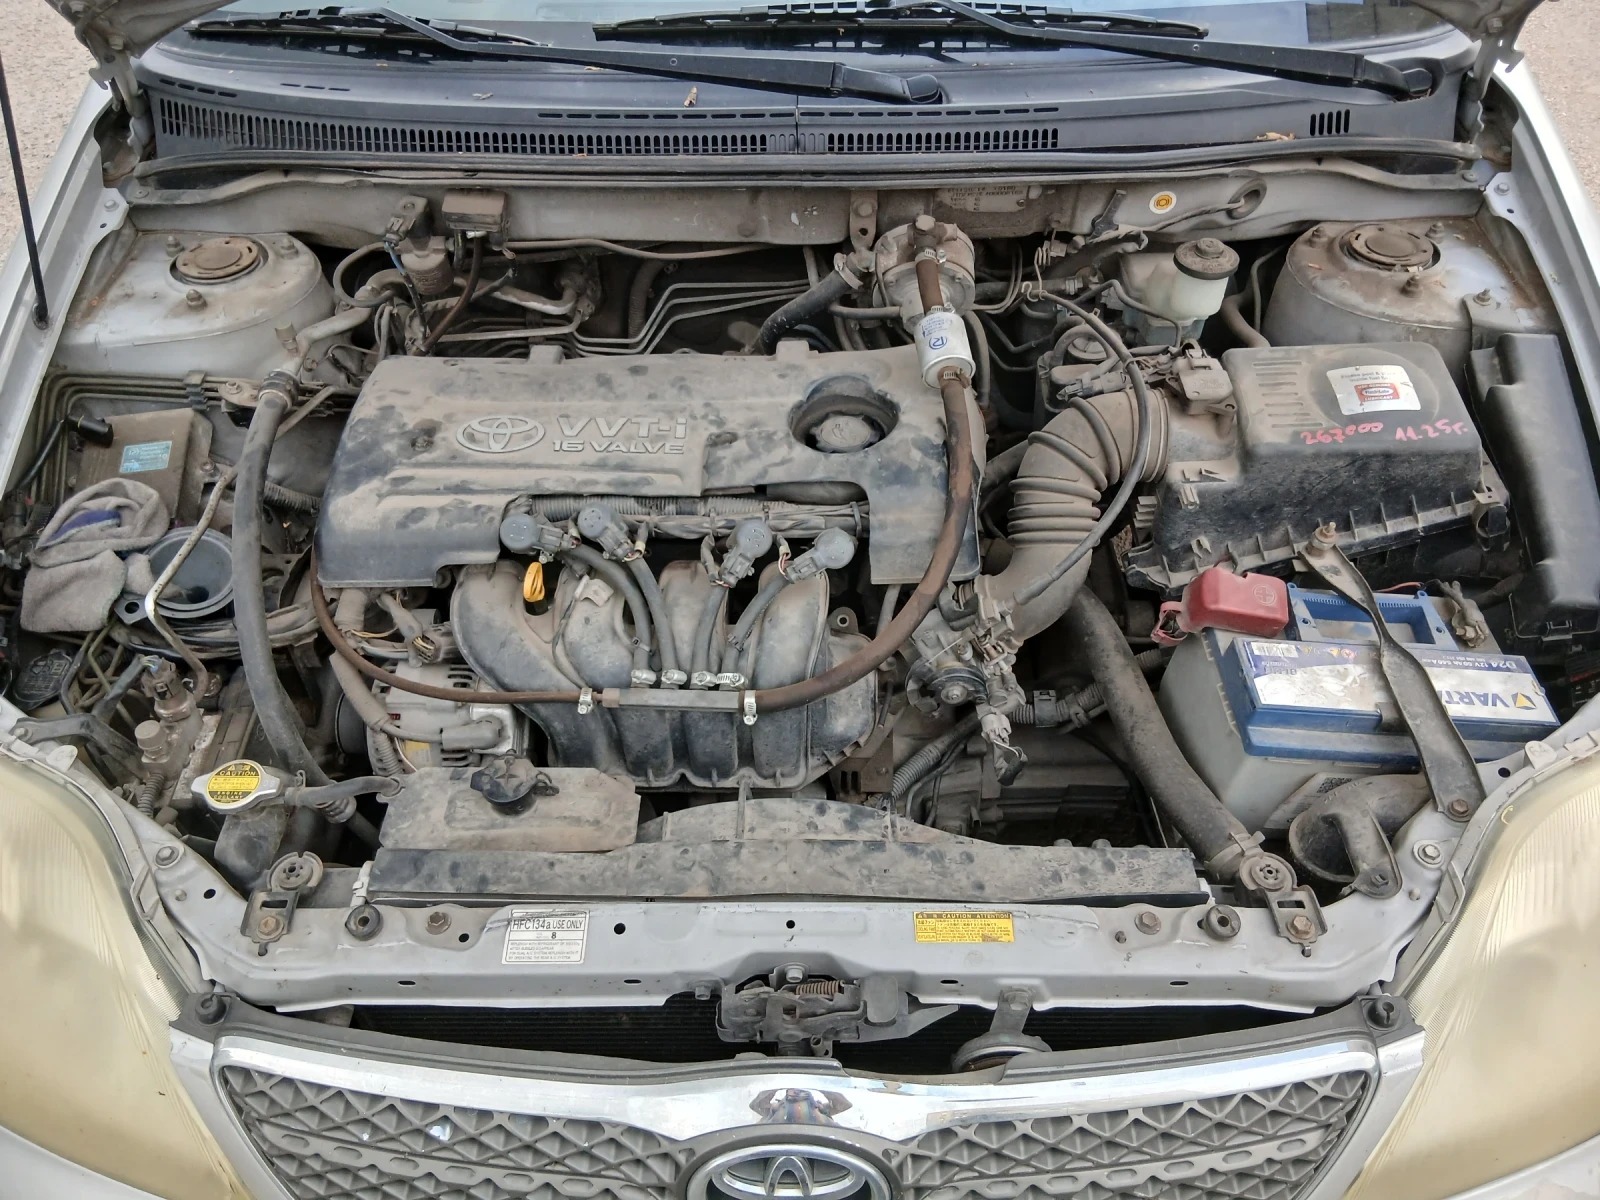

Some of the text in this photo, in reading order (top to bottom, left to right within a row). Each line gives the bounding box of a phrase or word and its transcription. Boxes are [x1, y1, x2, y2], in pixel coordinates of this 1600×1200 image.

[556, 417, 687, 439] VVT-i
[1301, 422, 1384, 445] 267000
[552, 440, 685, 454] 16 VALVE
[552, 919, 566, 929] USE
[566, 919, 584, 929] ONLY
[551, 931, 557, 939] 8
